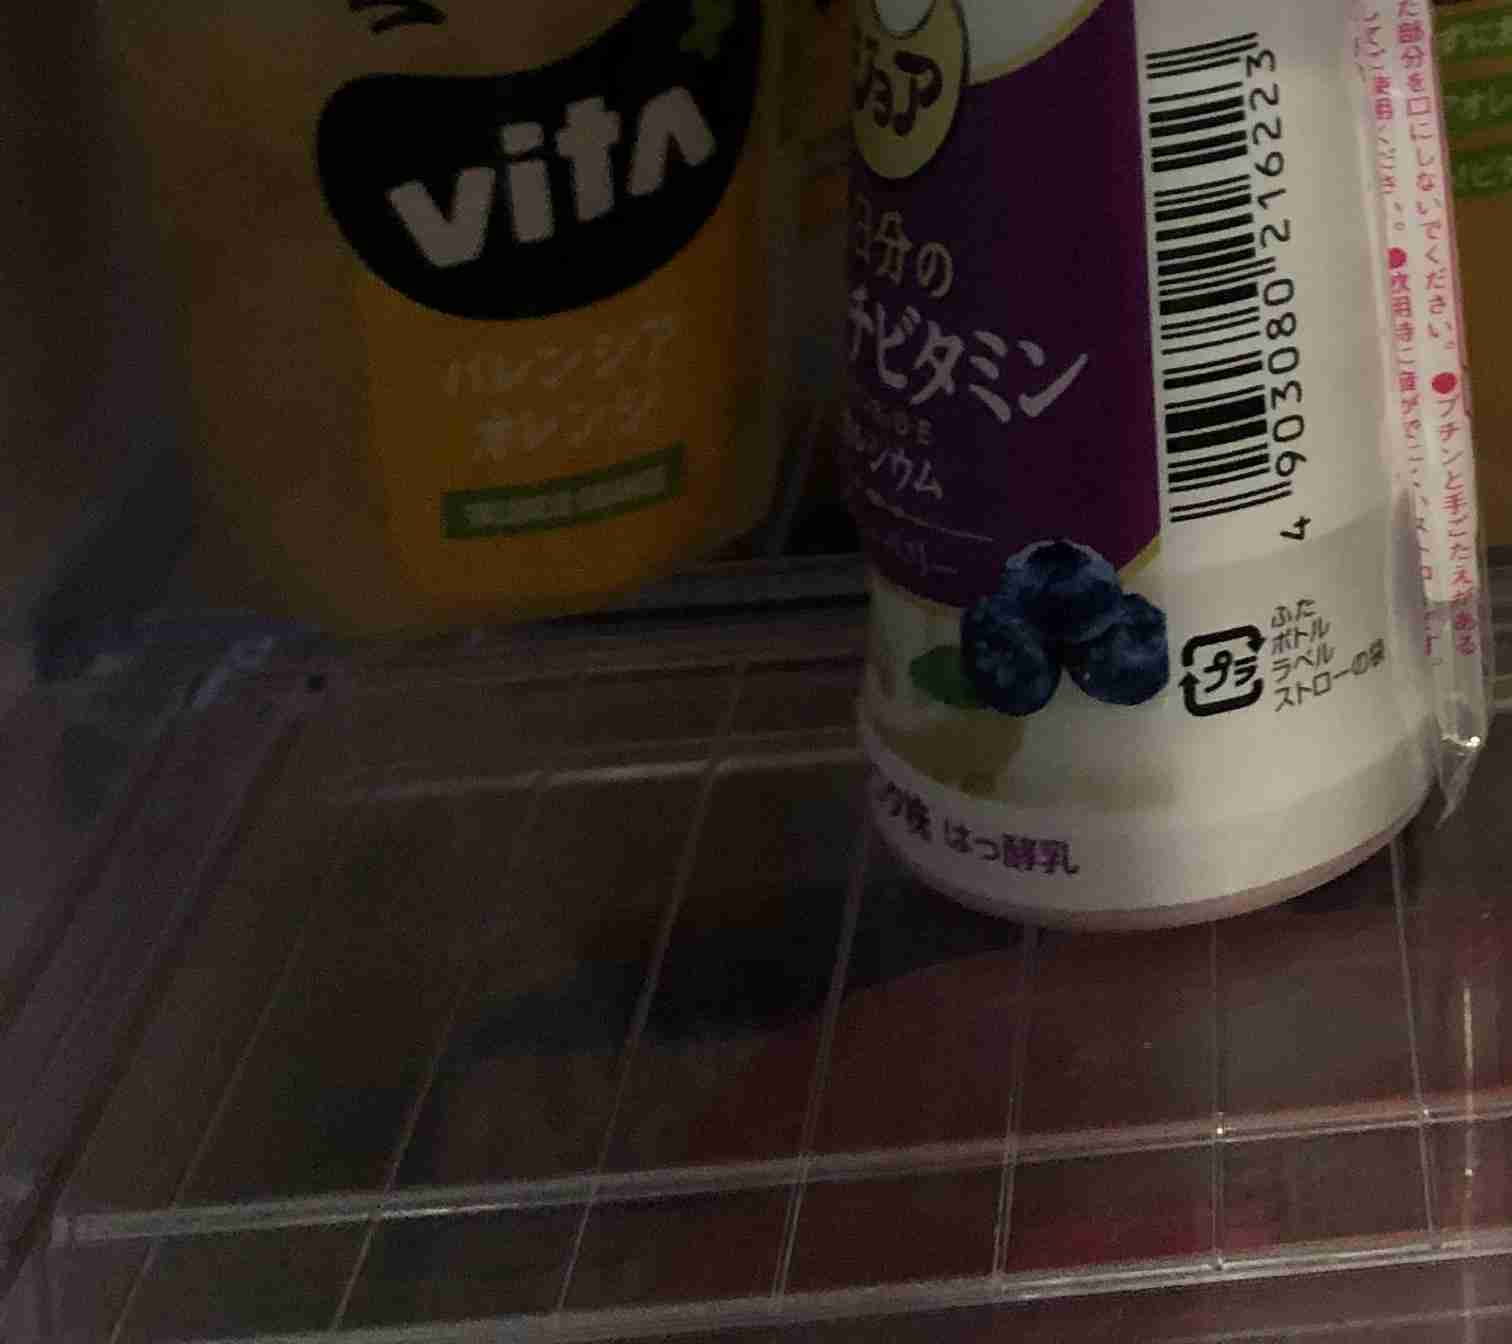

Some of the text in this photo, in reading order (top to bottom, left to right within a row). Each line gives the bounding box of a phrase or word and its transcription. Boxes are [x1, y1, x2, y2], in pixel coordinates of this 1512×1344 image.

[1246, 48, 1312, 542] 216223 903080 4
[1271, 598, 1317, 629] ふた
[1271, 615, 1333, 657] ボトル
[1202, 648, 1260, 694] プラ
[1271, 641, 1337, 683] ラベル
